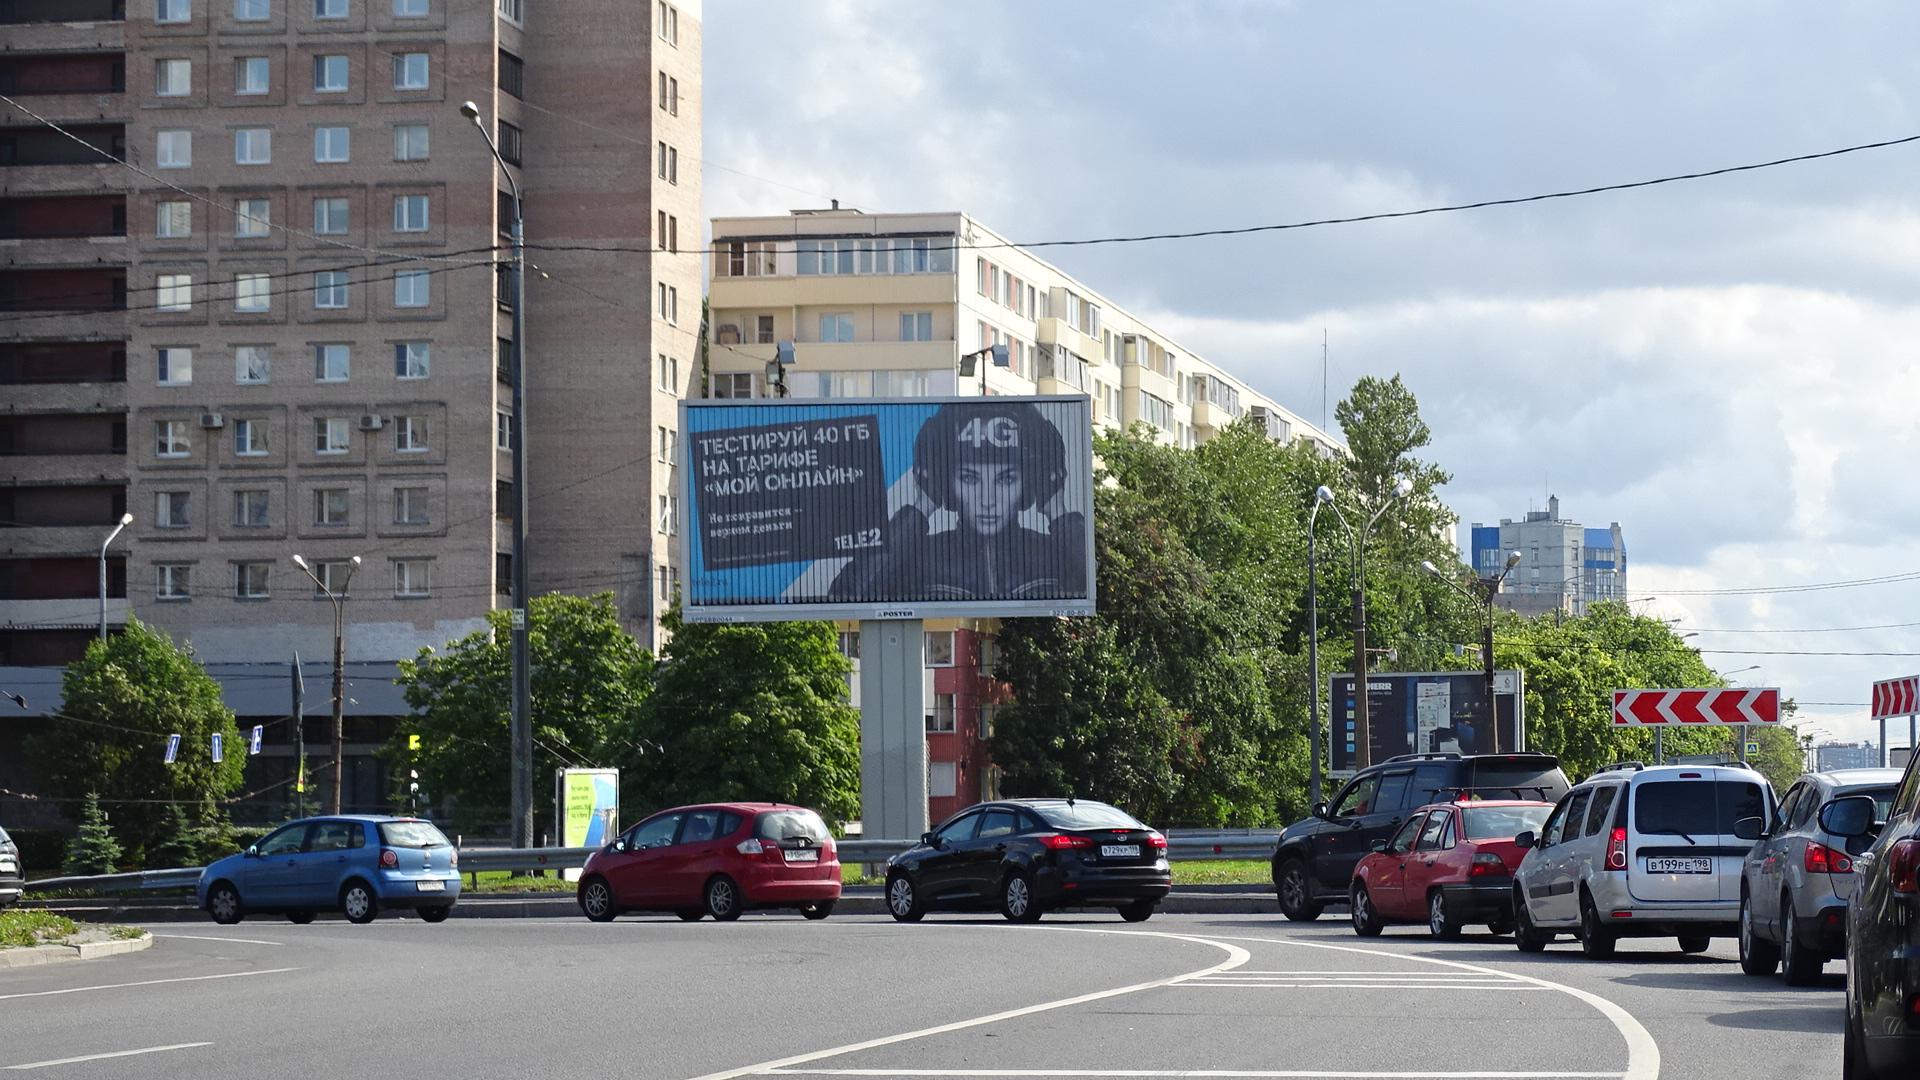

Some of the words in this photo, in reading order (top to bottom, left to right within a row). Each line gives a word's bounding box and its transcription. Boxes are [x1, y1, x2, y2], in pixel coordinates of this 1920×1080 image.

[699, 426, 807, 455] ТЕСТИРУЙ
[813, 426, 838, 444] 40
[844, 424, 870, 442] ГБ
[958, 416, 1018, 448] 4G
[702, 459, 730, 477] НА
[736, 449, 819, 472] ТАРИФЕ
[834, 528, 883, 550] TELE2
[1346, 683, 1392, 691] LIHERR
[1693, 859, 1708, 868] 198
